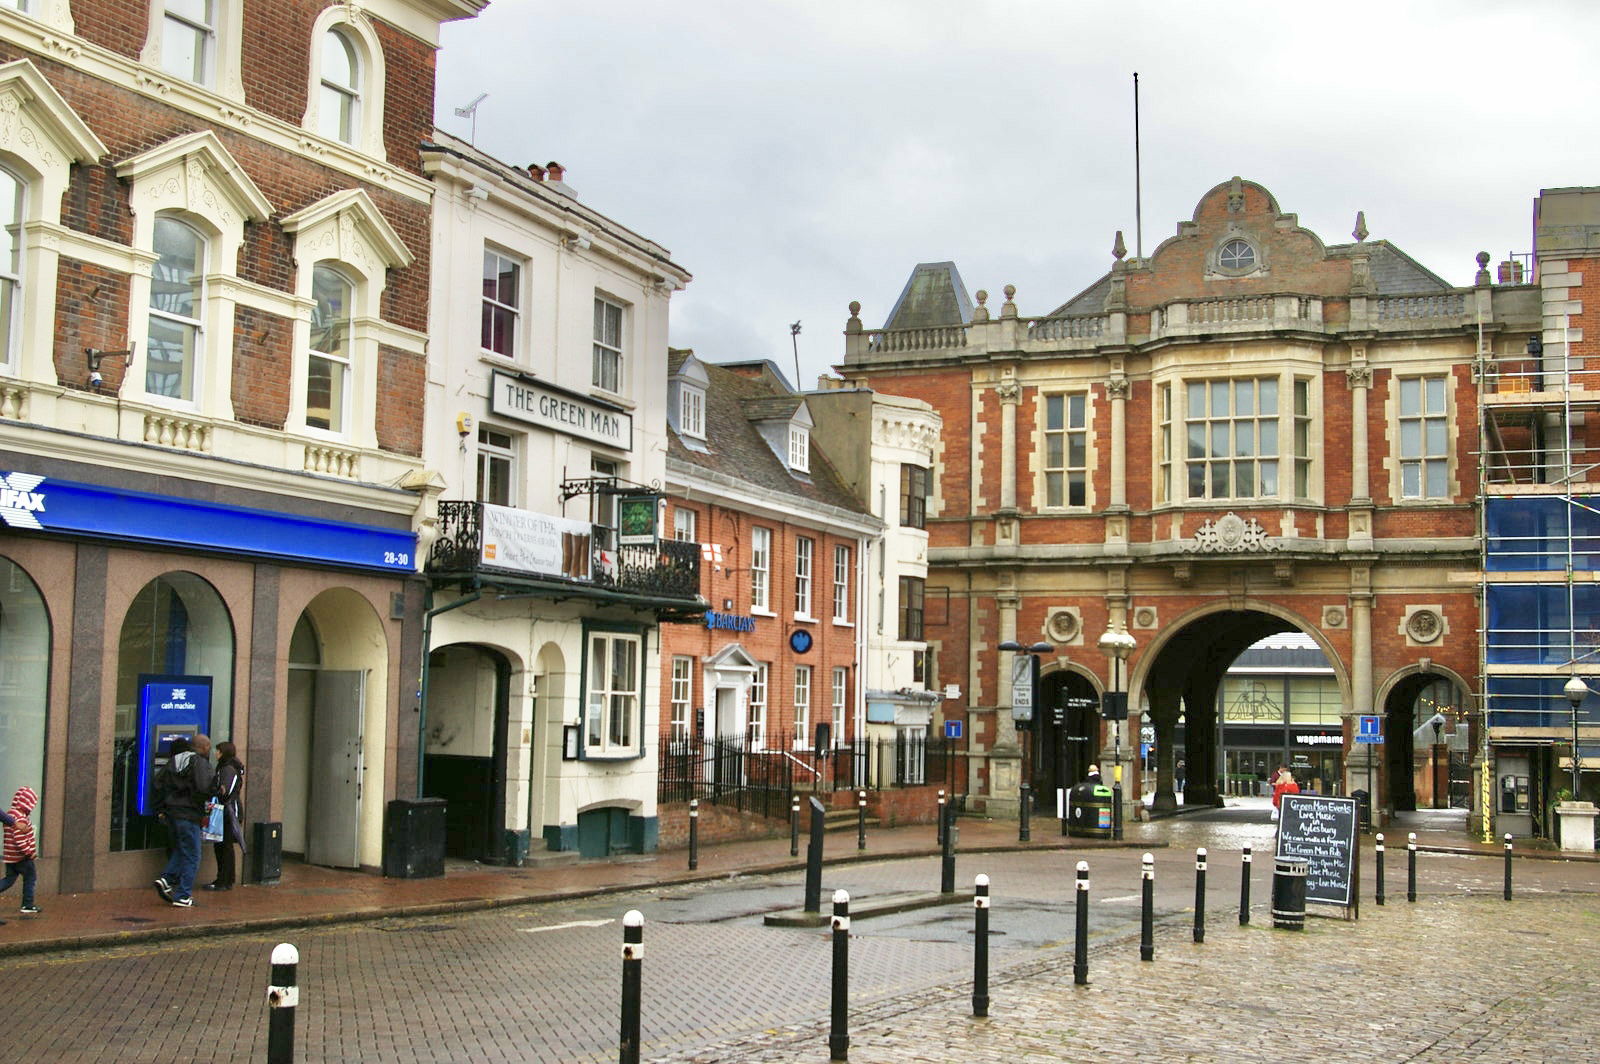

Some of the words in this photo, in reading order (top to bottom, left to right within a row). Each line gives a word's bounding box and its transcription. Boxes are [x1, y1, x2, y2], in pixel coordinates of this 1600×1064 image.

[505, 384, 534, 412] THE
[539, 395, 586, 428] GREEN
[591, 410, 620, 439] MAN
[0, 488, 46, 512] IFAX
[384, 551, 408, 565] 28-30
[715, 613, 756, 632] BARCLAYS
[161, 702, 173, 710] cash
[174, 702, 196, 710] machine
[1290, 799, 1313, 811] Green
[1313, 800, 1328, 811] Man
[1299, 810, 1314, 819] Live
[1315, 811, 1336, 821] Music
[1282, 831, 1292, 840] We
[1299, 822, 1337, 839] Aylesbury
[1284, 843, 1297, 853] The
[1296, 844, 1313, 854] Green
[1329, 847, 1342, 856] Pub
[1322, 869, 1341, 878] Music
[1330, 880, 1347, 889] Music
